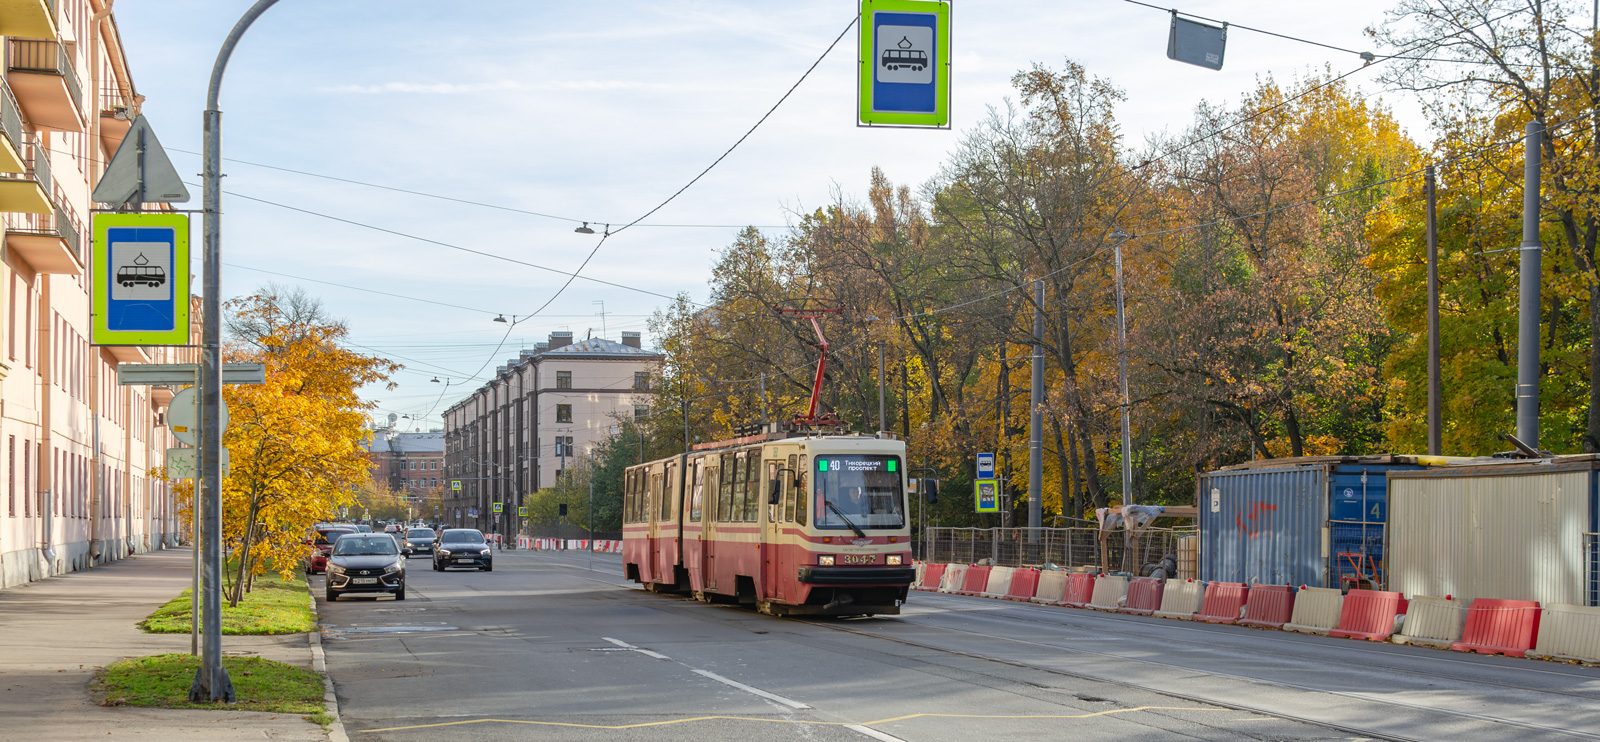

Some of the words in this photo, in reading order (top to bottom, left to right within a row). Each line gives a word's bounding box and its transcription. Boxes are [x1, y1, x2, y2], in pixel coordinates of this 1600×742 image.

[830, 460, 840, 471] 40
[1371, 503, 1380, 519] 4
[844, 555, 876, 565] 3047
